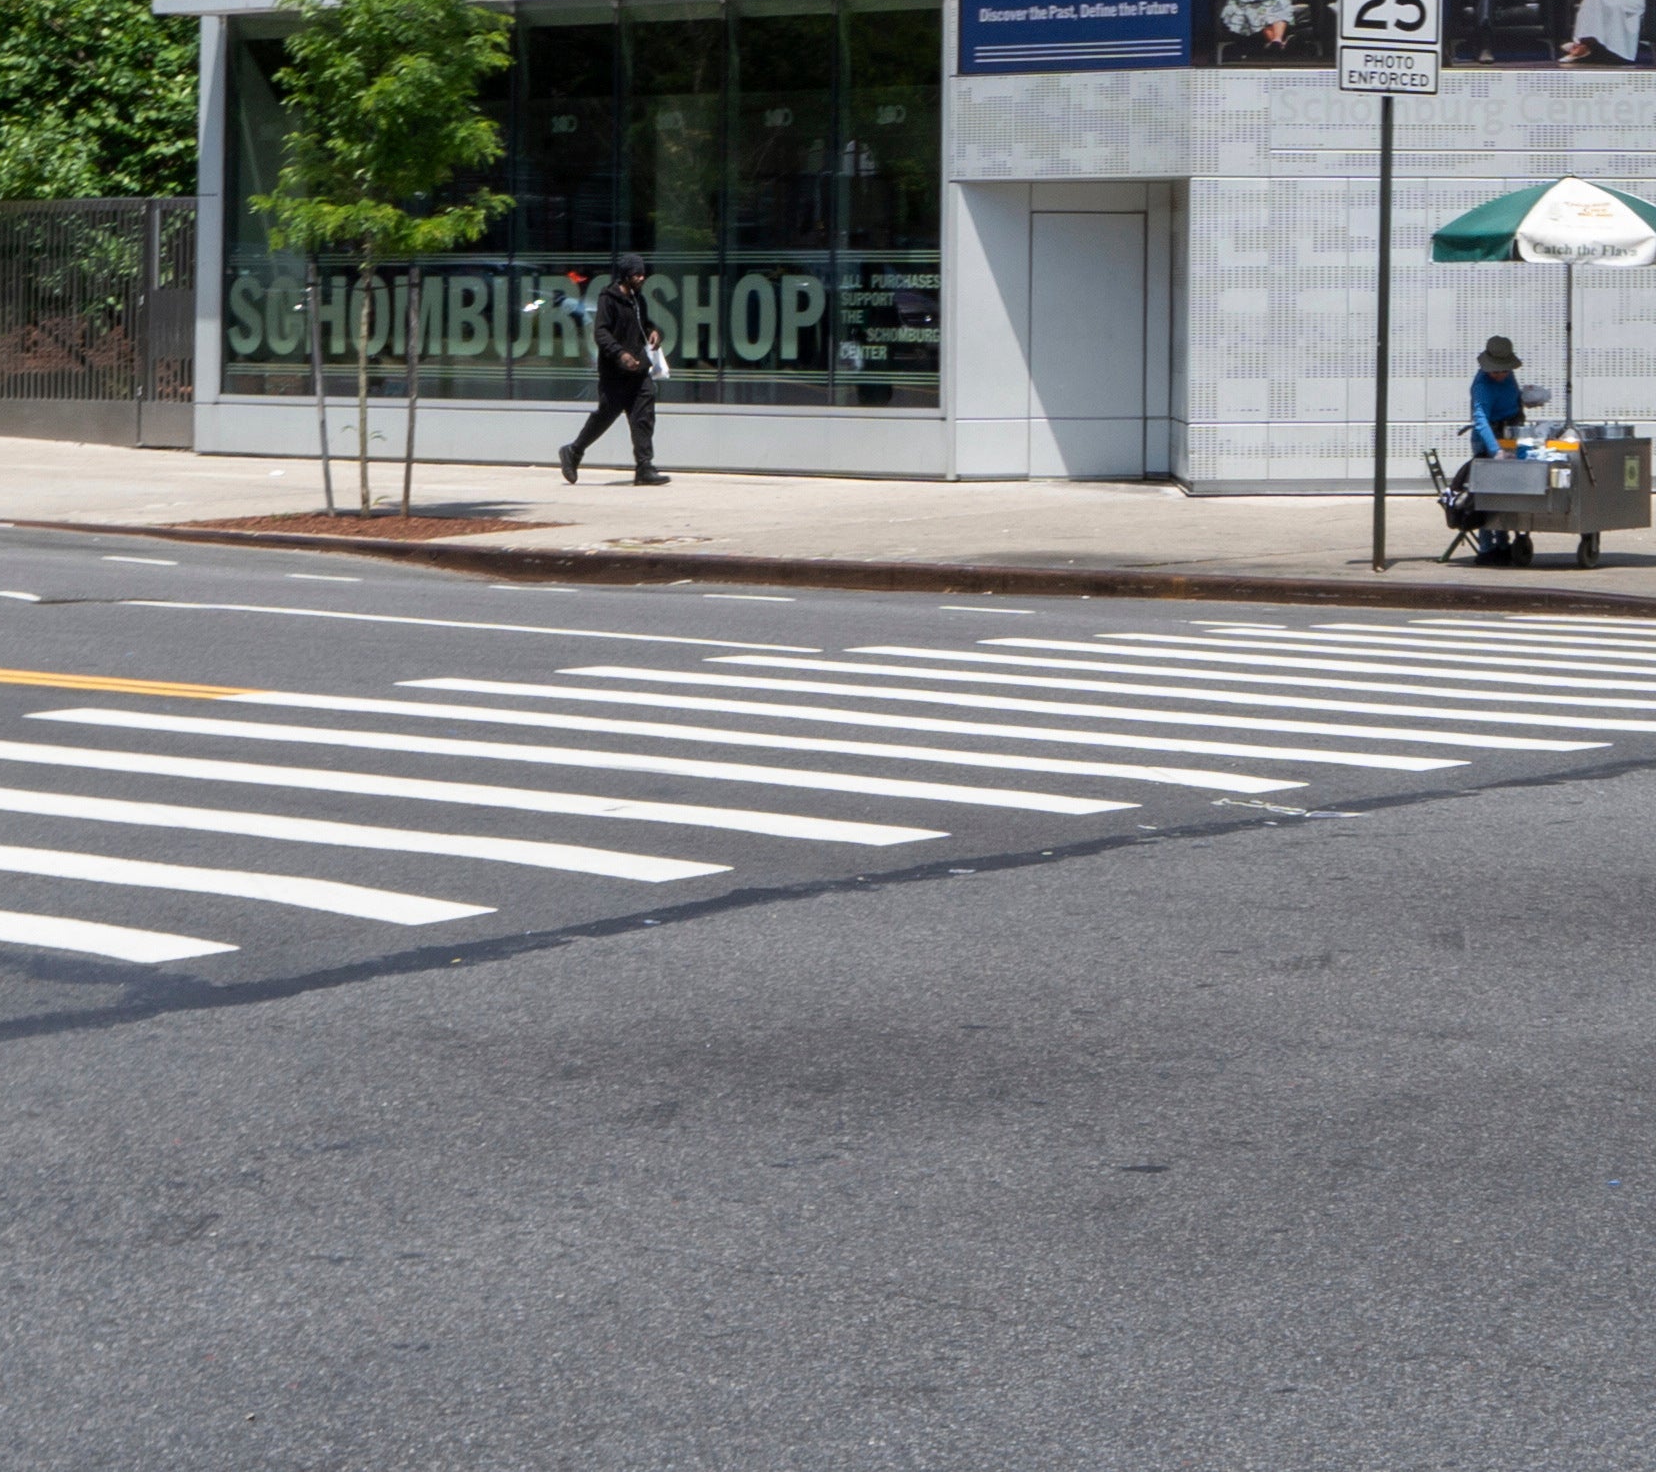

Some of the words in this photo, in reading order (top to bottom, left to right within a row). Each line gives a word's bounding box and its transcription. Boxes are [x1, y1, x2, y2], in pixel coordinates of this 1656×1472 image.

[979, 6, 1028, 22] Discover
[1029, 5, 1047, 20] the
[1048, 5, 1078, 20] Past,
[1080, 3, 1117, 18] Define
[1118, 2, 1137, 17] the
[1138, 1, 1179, 16] Future
[1364, 54, 1414, 70] PHOTO
[1348, 70, 1430, 87] ENFORCED
[1519, 91, 1655, 125] Center
[1532, 241, 1573, 256] Catch
[1577, 243, 1597, 256] the
[840, 274, 862, 288] ALL
[871, 274, 941, 289] PURCHASES
[841, 292, 895, 306] SUPPORT
[641, 274, 826, 361] SHOP
[840, 309, 864, 324] THE
[866, 327, 941, 342] SCHOMBURG
[840, 343, 887, 360] CENTER
